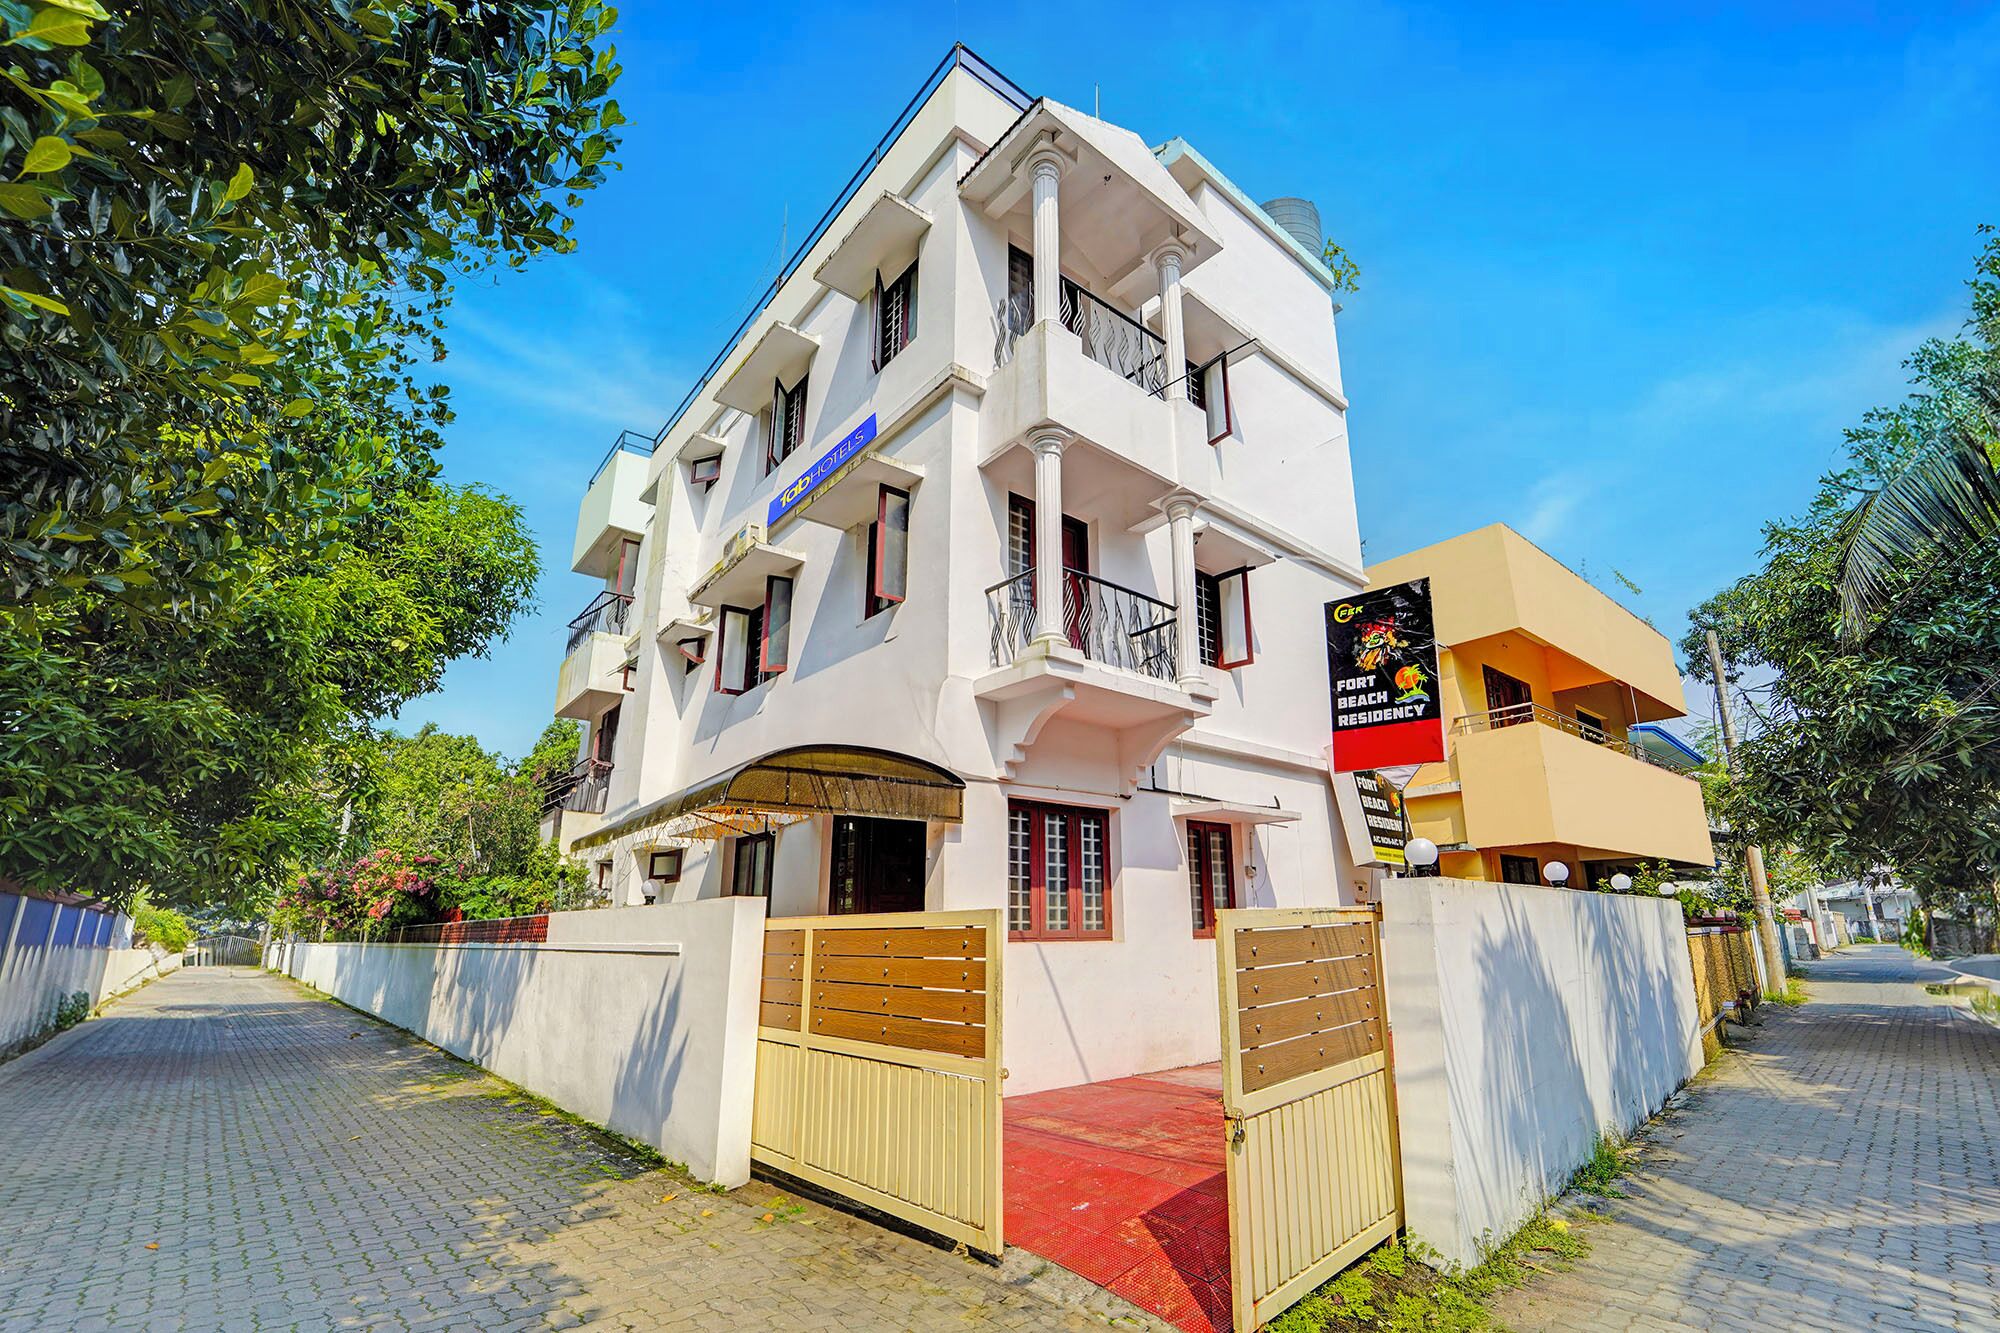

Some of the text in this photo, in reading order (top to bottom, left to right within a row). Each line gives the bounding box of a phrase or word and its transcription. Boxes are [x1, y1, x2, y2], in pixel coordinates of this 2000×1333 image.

[780, 430, 864, 508] fabHOTELS
[1336, 675, 1377, 692] FORT
[1337, 690, 1389, 709] BEACH
[1338, 704, 1426, 727] RESIDENCY
[1356, 776, 1379, 792] FORT
[1361, 795, 1389, 812] BEACH
